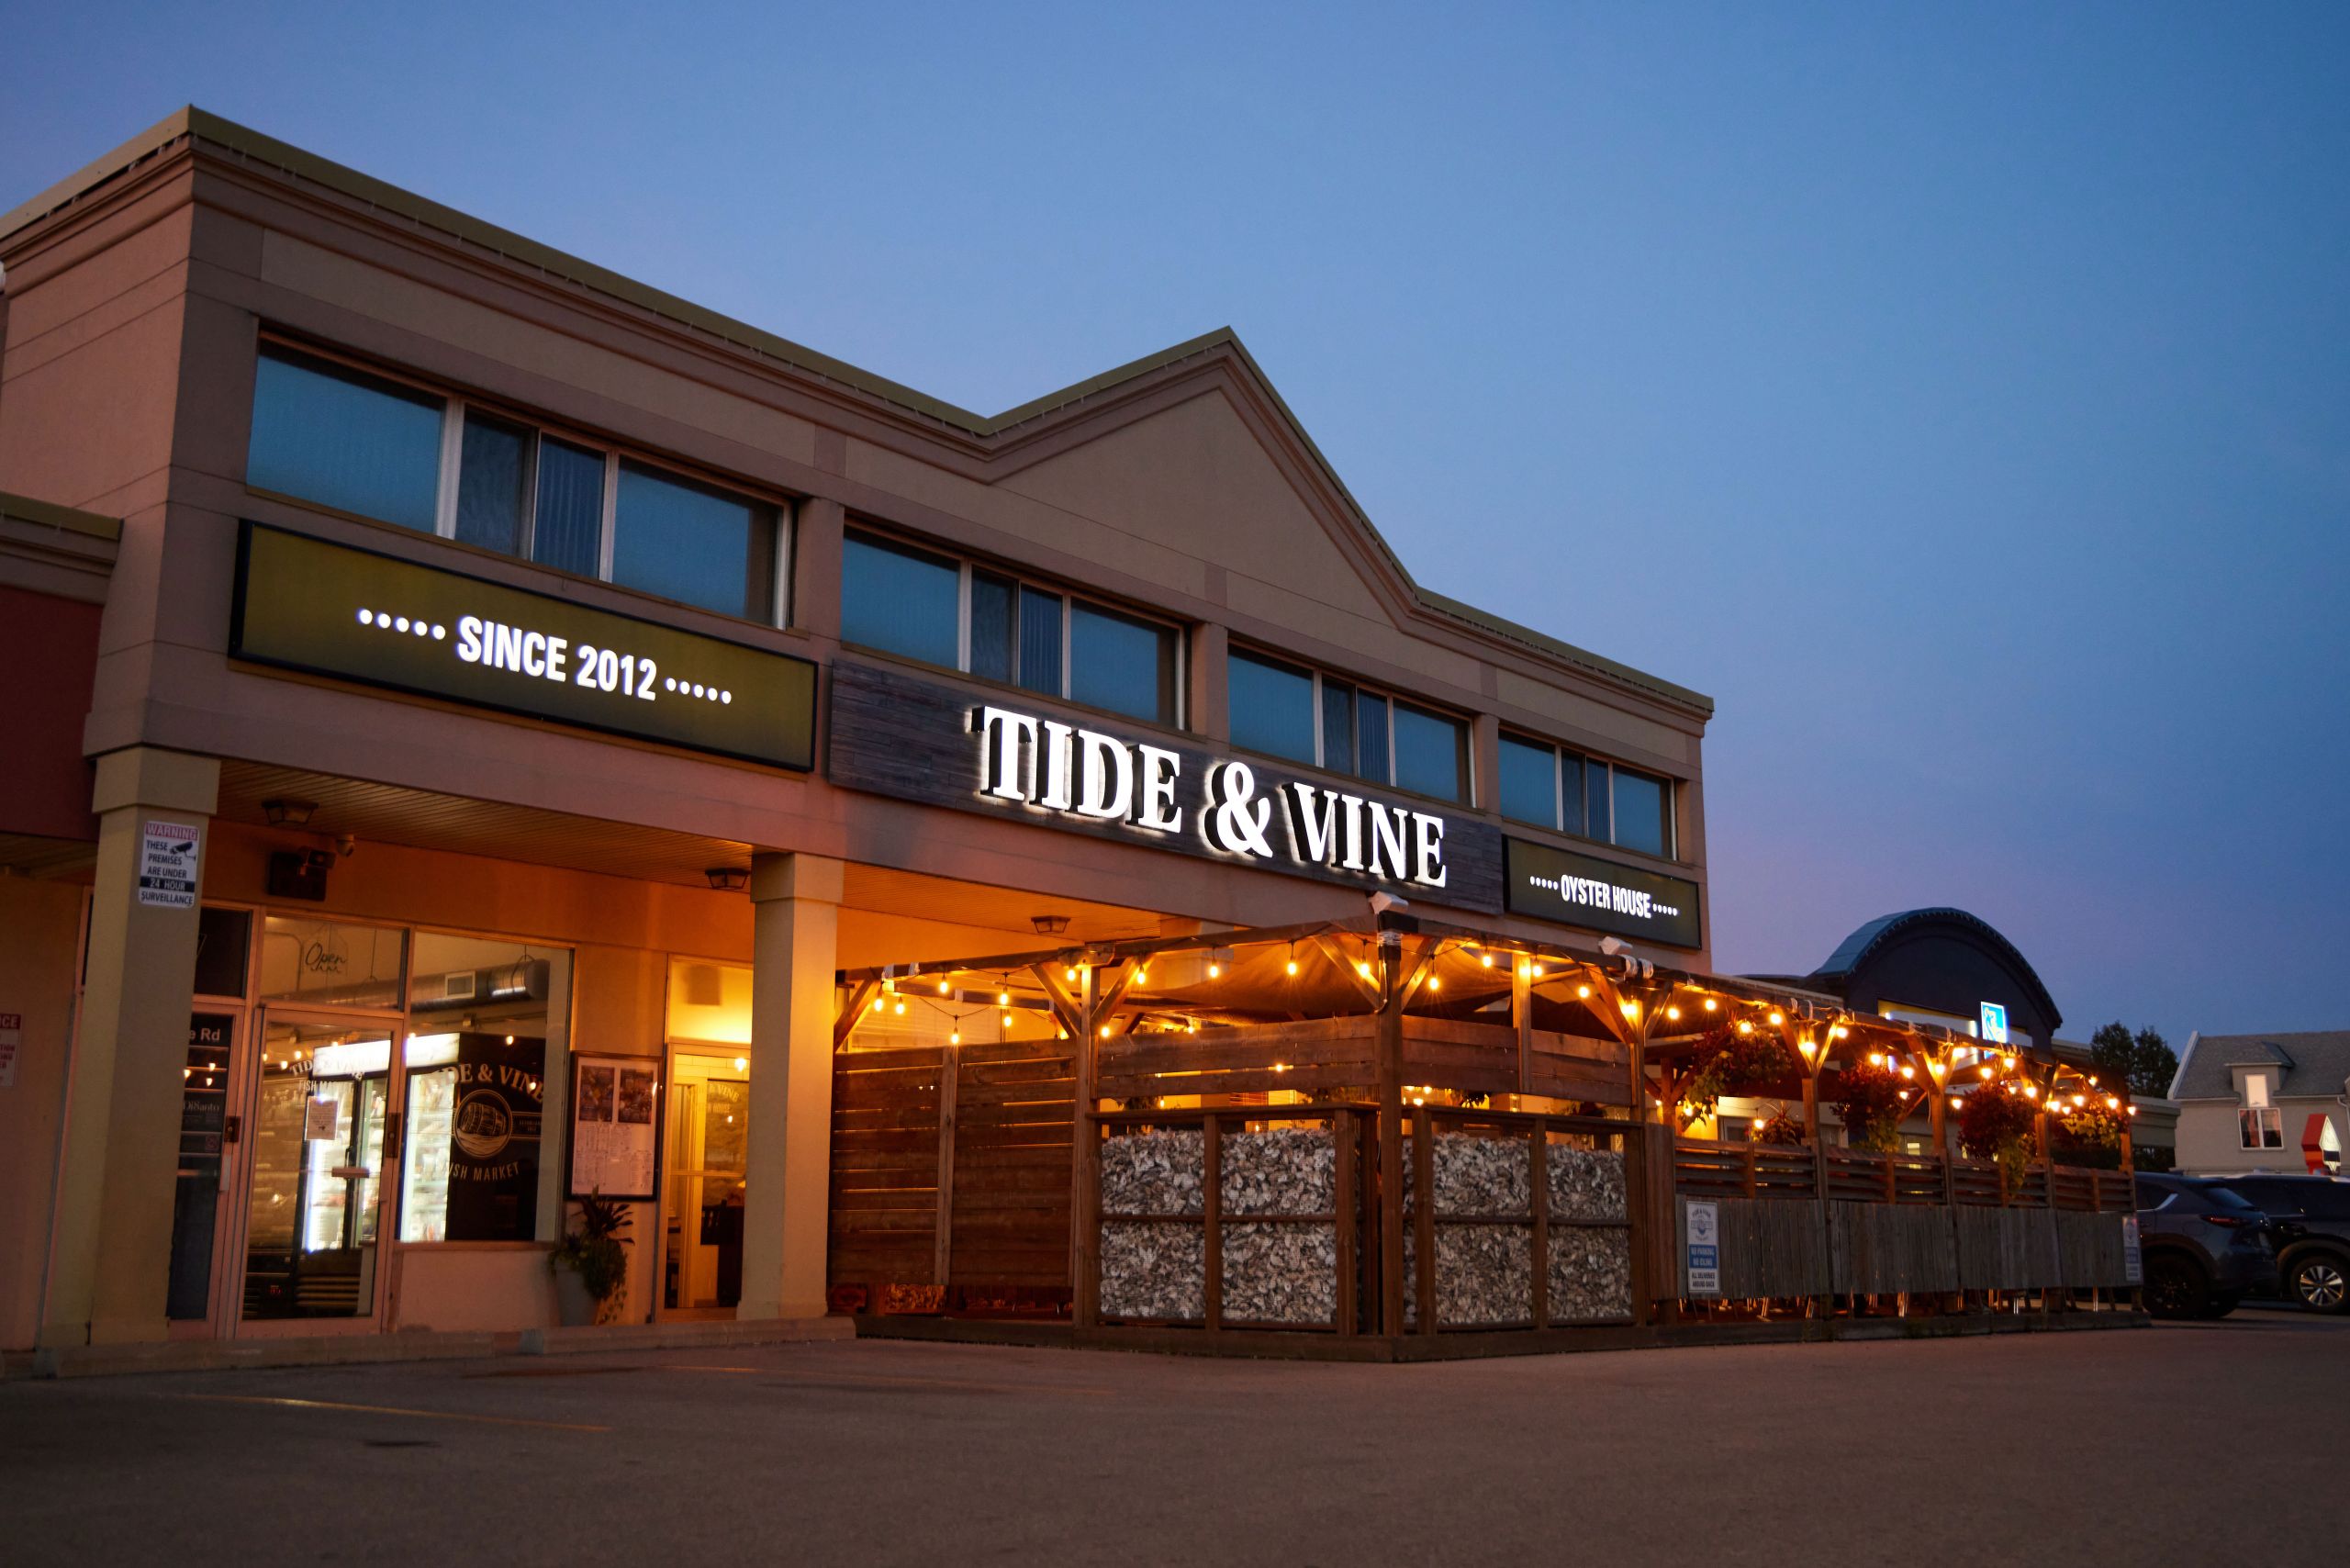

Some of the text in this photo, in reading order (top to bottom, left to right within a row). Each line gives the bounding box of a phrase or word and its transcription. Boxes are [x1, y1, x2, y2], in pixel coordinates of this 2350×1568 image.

[457, 616, 657, 701] SINCE 2012
[973, 706, 1447, 889] TIDE & VINE
[147, 823, 199, 840] WARNING
[147, 840, 168, 851] THESE
[148, 853, 183, 866] PREMISES
[148, 866, 187, 879] ARE UNDER
[150, 878, 185, 891] 24 HOUR
[141, 890, 193, 905] SURVEILLANCE
[1561, 874, 1651, 919] OYSTER HOUSE
[305, 941, 347, 970] Open
[200, 1028, 220, 1042] Rd
[477, 1063, 493, 1081] &
[473, 1160, 520, 1182] MARKET
